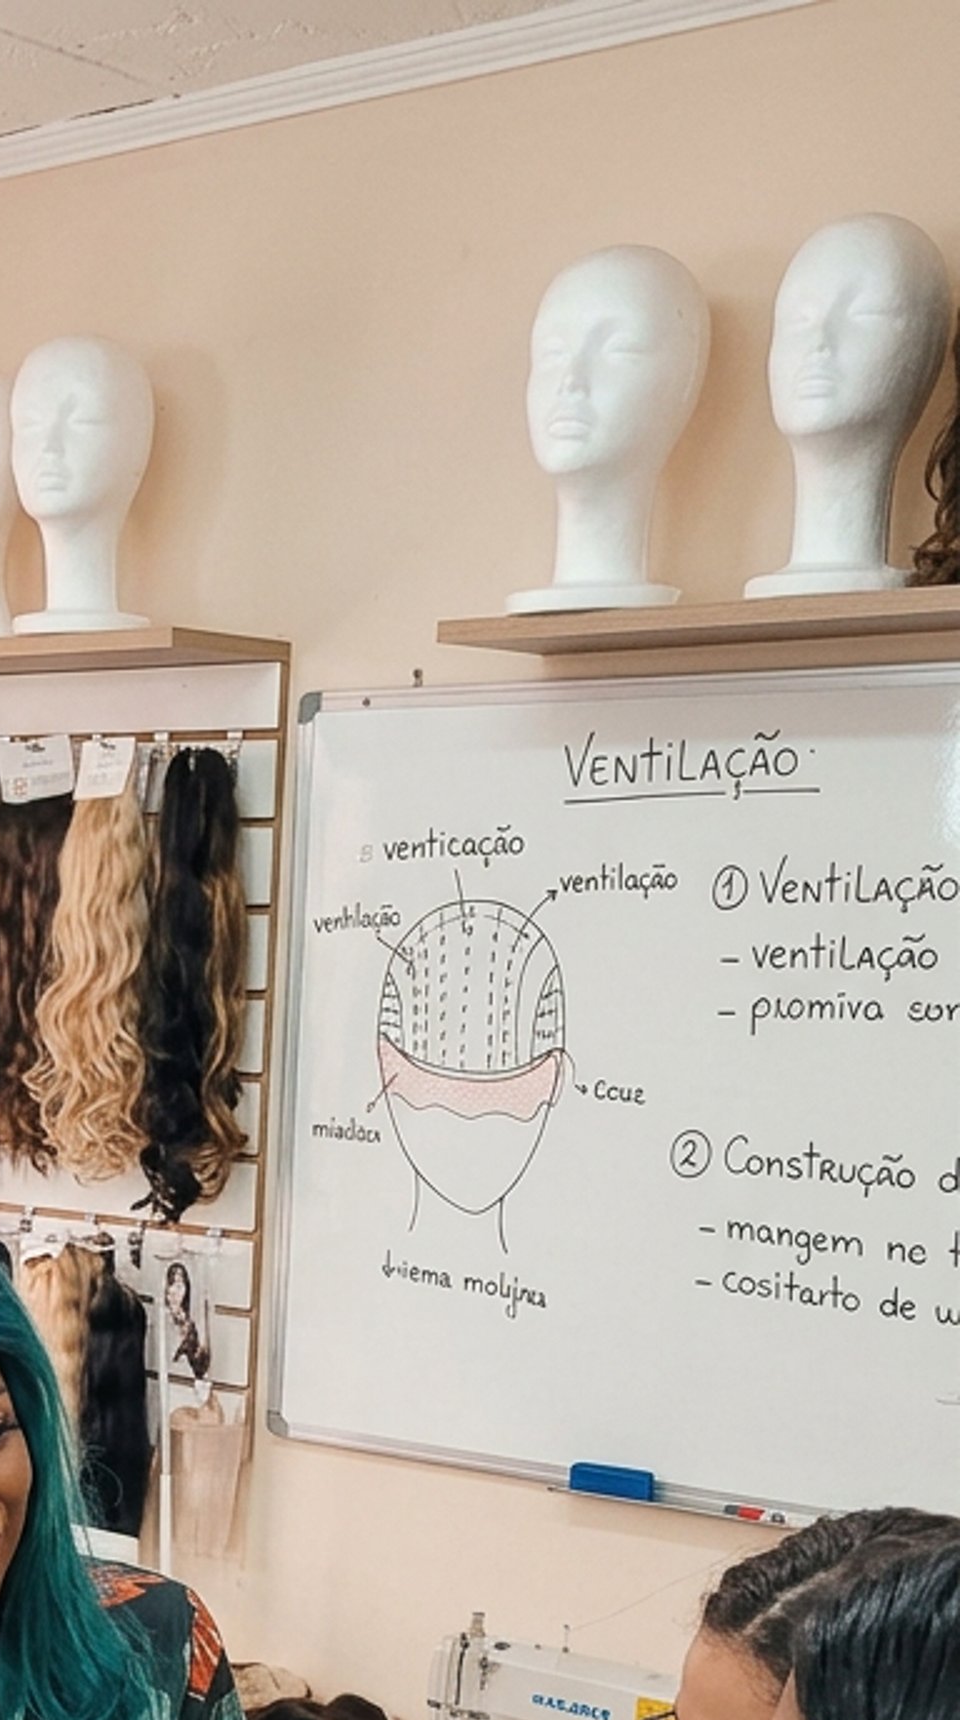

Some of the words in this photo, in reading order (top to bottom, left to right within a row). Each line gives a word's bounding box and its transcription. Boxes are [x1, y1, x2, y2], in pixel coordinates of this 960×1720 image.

[726, 1220, 864, 1266] mangem
[721, 1270, 861, 1312] cositarto
[878, 1285, 917, 1321] de
